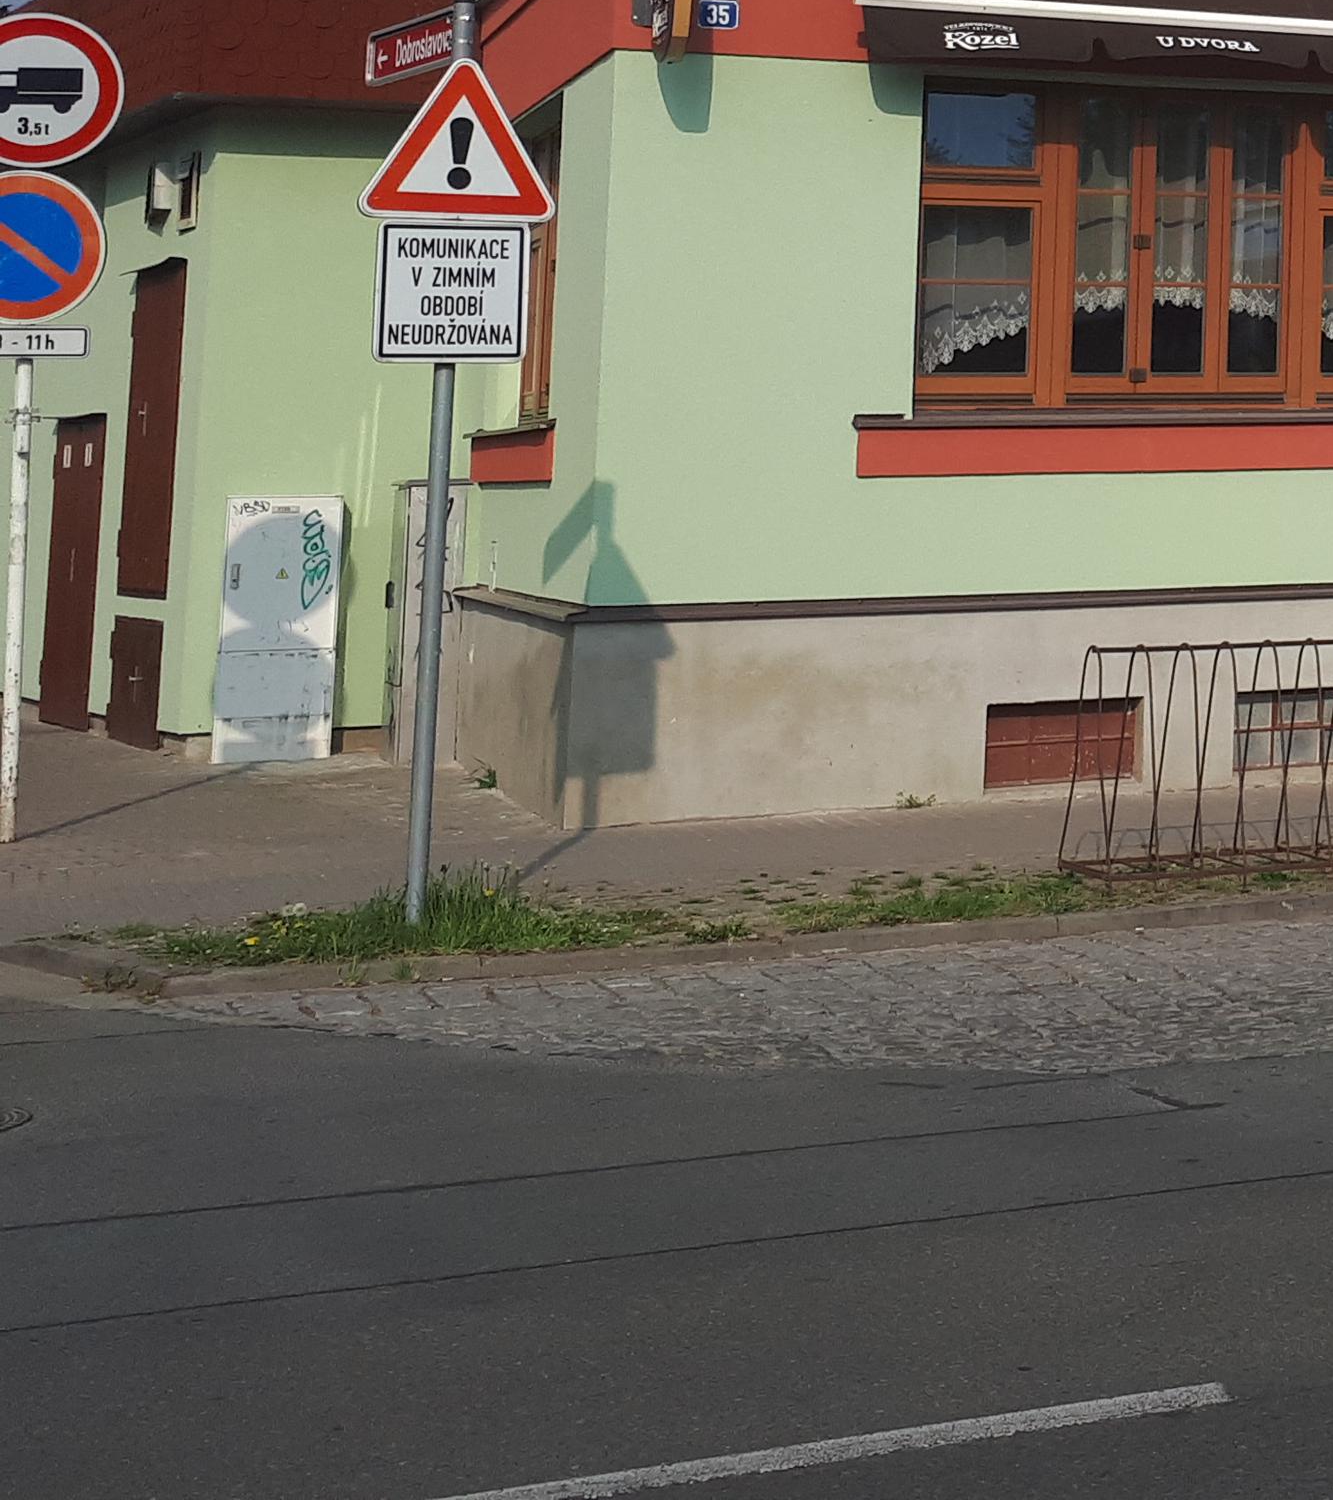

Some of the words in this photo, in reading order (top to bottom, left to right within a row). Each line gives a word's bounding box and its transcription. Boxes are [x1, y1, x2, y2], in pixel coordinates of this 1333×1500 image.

[706, 4, 730, 25] 35
[943, 31, 1020, 51] Kozel
[1155, 36, 1174, 48] U
[1177, 37, 1261, 52] DVORA
[397, 237, 510, 260] KOMUNIKACE
[411, 266, 423, 288] V
[432, 261, 496, 288] ZIMNÍM
[420, 290, 484, 317] OBDOBÍ
[387, 318, 513, 346] NEUDRŽOVÁNA
